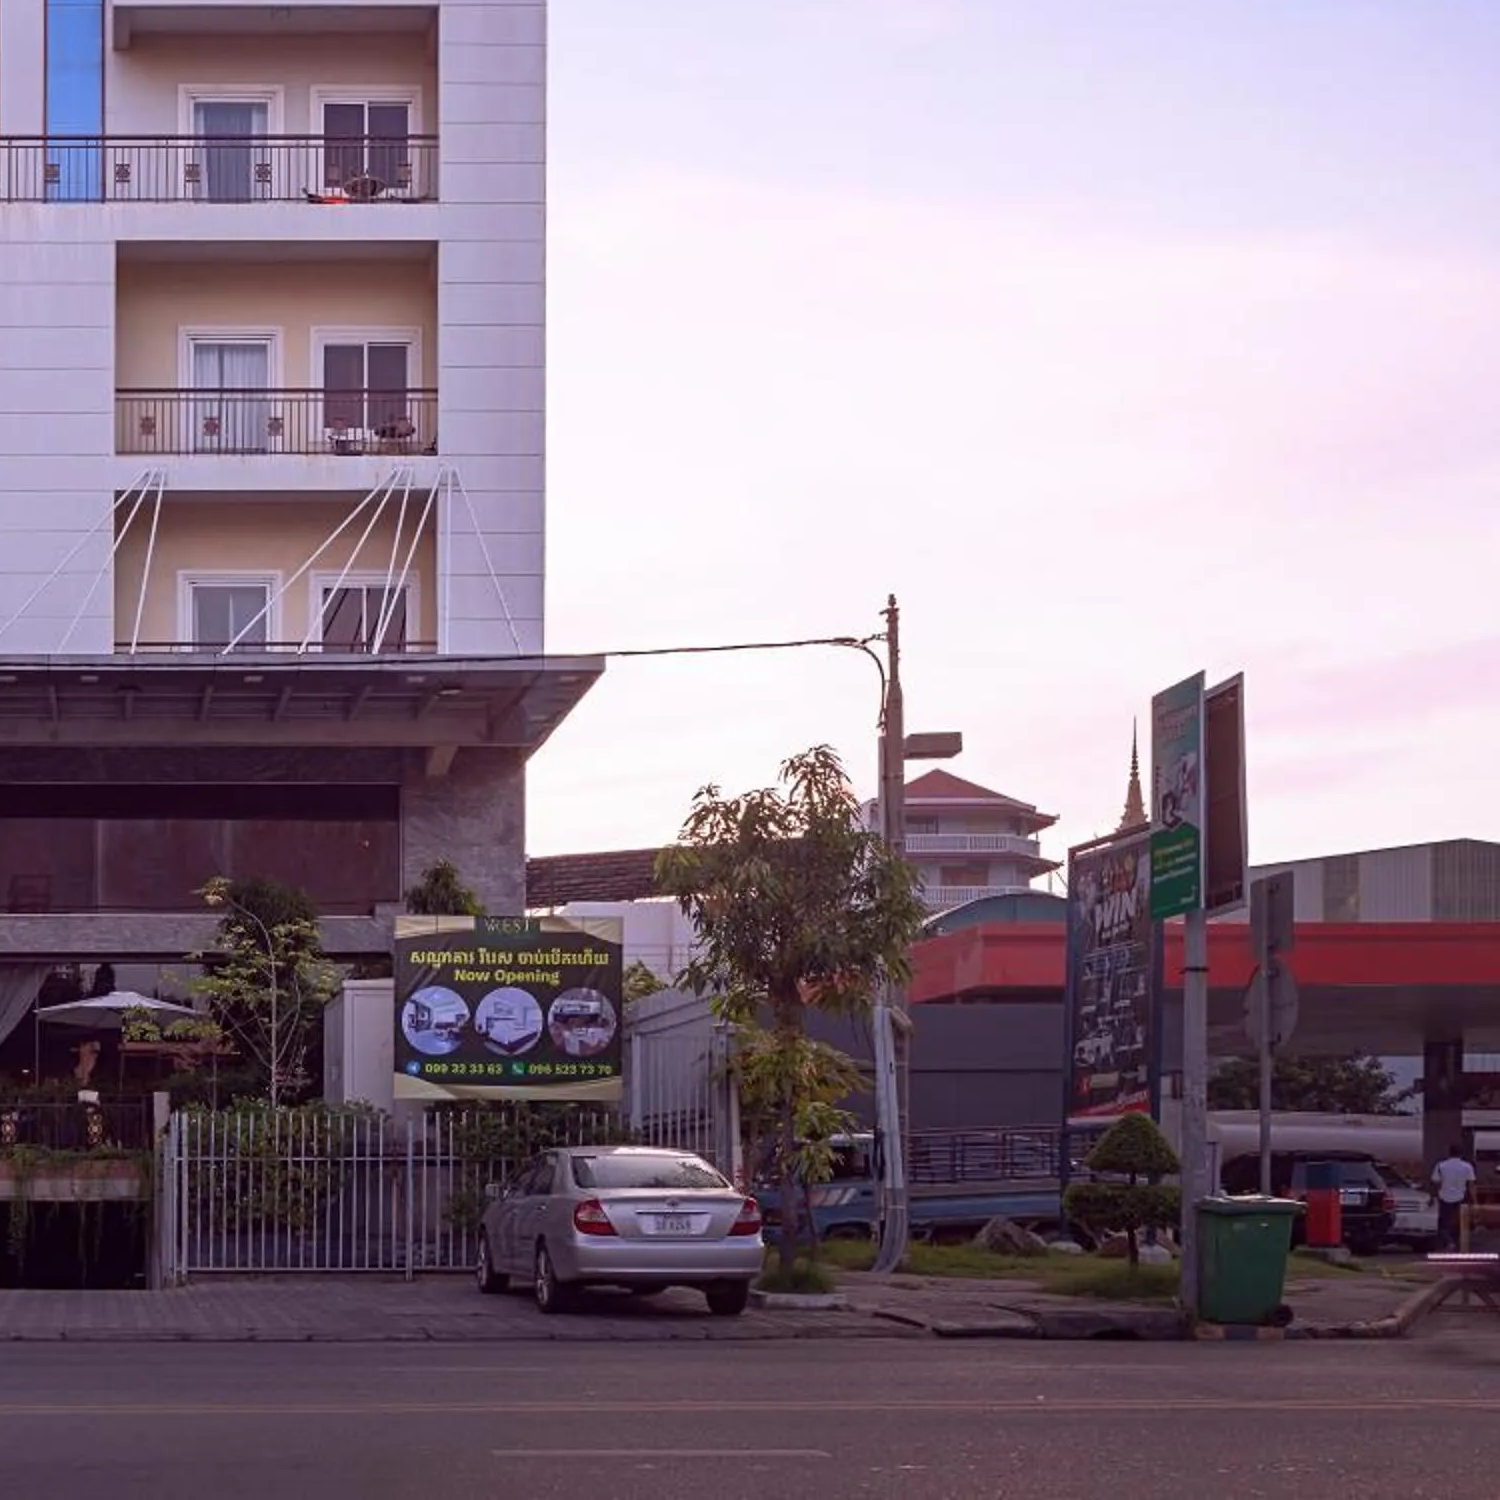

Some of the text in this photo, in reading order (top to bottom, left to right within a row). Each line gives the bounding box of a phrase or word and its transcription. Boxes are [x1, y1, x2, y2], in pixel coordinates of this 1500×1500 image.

[1094, 887, 1138, 933] WIN
[453, 968, 561, 987] Now Opening
